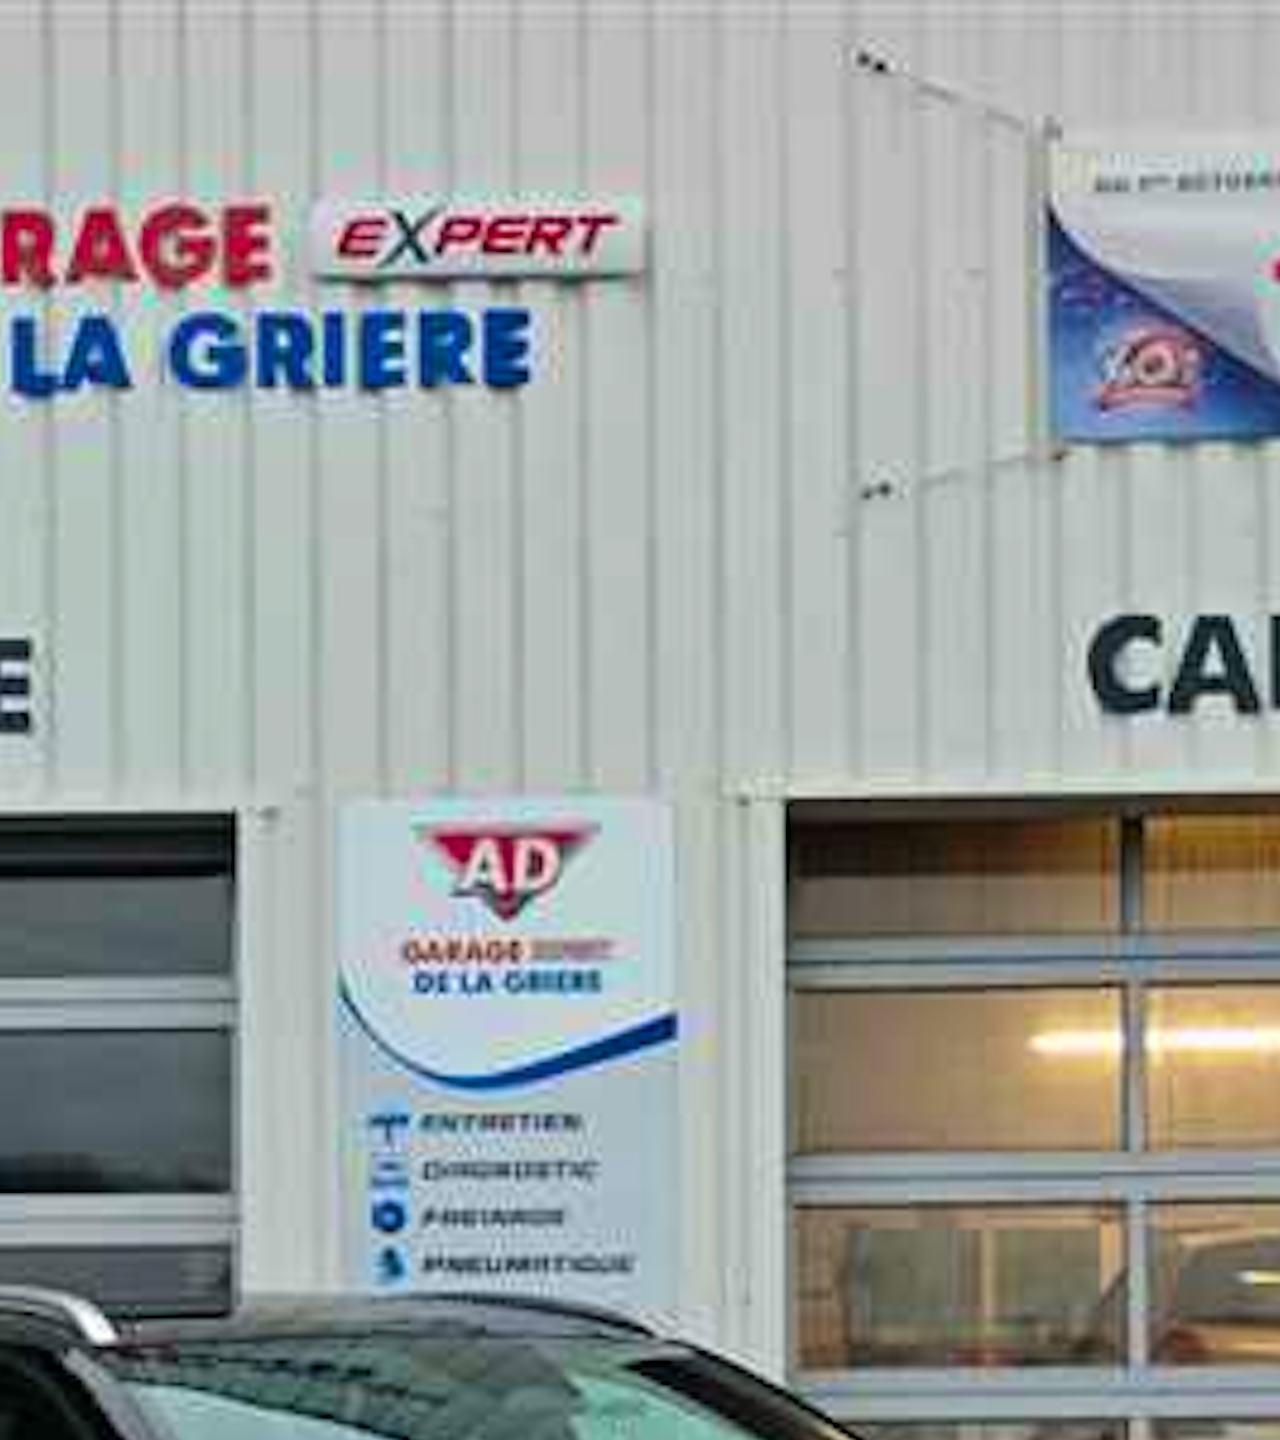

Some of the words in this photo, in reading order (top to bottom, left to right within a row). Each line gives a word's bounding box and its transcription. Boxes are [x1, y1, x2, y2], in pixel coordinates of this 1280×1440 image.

[336, 208, 619, 268] EXPERT
[10, 316, 132, 399] LA
[167, 308, 534, 393] GRIERE
[458, 835, 562, 893] AD
[403, 939, 523, 964] GARAGE
[414, 969, 447, 994] DE
[460, 969, 493, 994] LA
[421, 1113, 584, 1133] ENTRETIEN
[423, 1160, 601, 1181] DIAGNOSTIC
